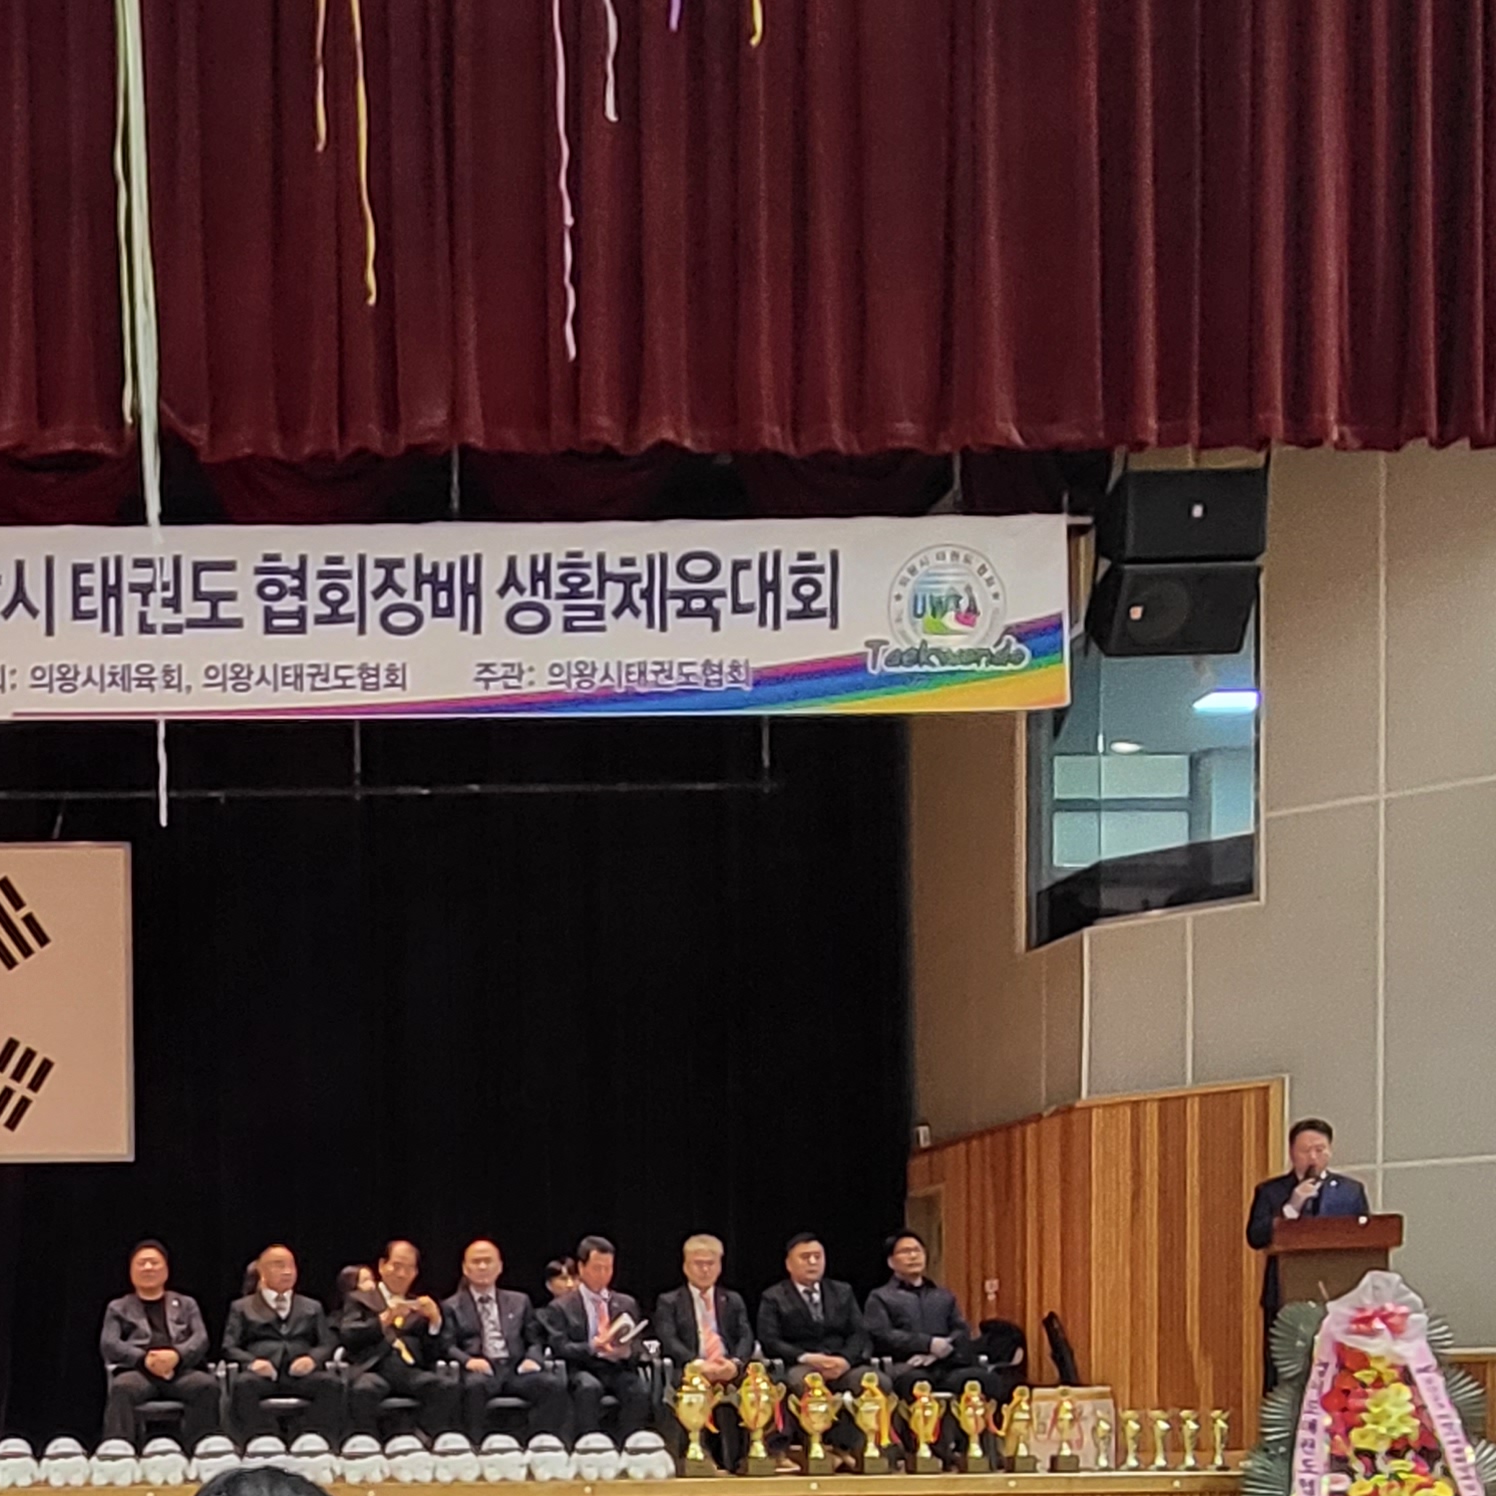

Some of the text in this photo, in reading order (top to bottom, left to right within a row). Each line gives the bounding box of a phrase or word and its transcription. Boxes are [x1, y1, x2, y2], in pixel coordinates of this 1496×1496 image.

[496, 549, 840, 636] 생활체육대회
[29, 663, 192, 693] 의왕시체육회,
[202, 662, 407, 692] 의왕시태권도협회
[473, 658, 751, 691] 주관: 의왕시태권도협회
